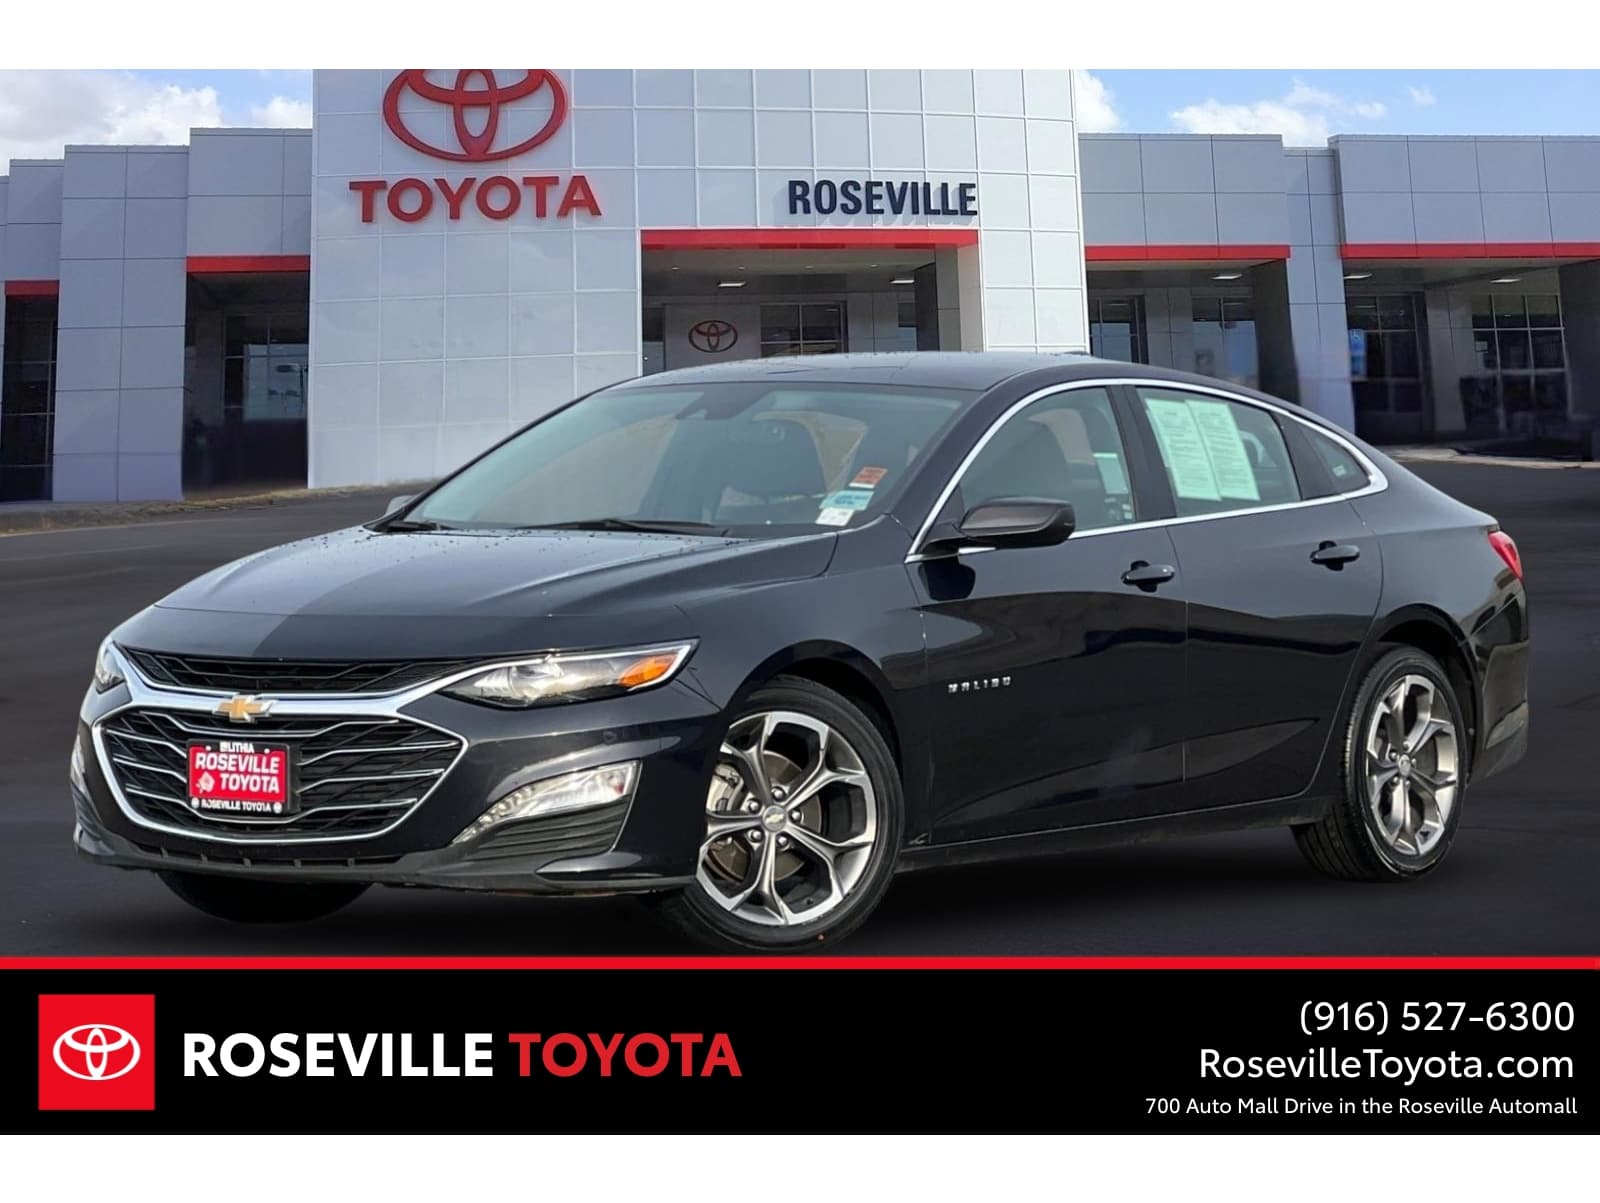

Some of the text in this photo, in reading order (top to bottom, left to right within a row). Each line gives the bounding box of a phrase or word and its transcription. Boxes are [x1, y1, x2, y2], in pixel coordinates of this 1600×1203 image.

[349, 175, 602, 224] TOYOTA
[788, 179, 978, 216] ROSEVILLE
[947, 675, 1011, 693] MALIBU
[195, 753, 281, 774] ROSEVILLE
[220, 773, 280, 793] TOYOTA
[201, 799, 272, 813] ROSEVILLE TOYOTA
